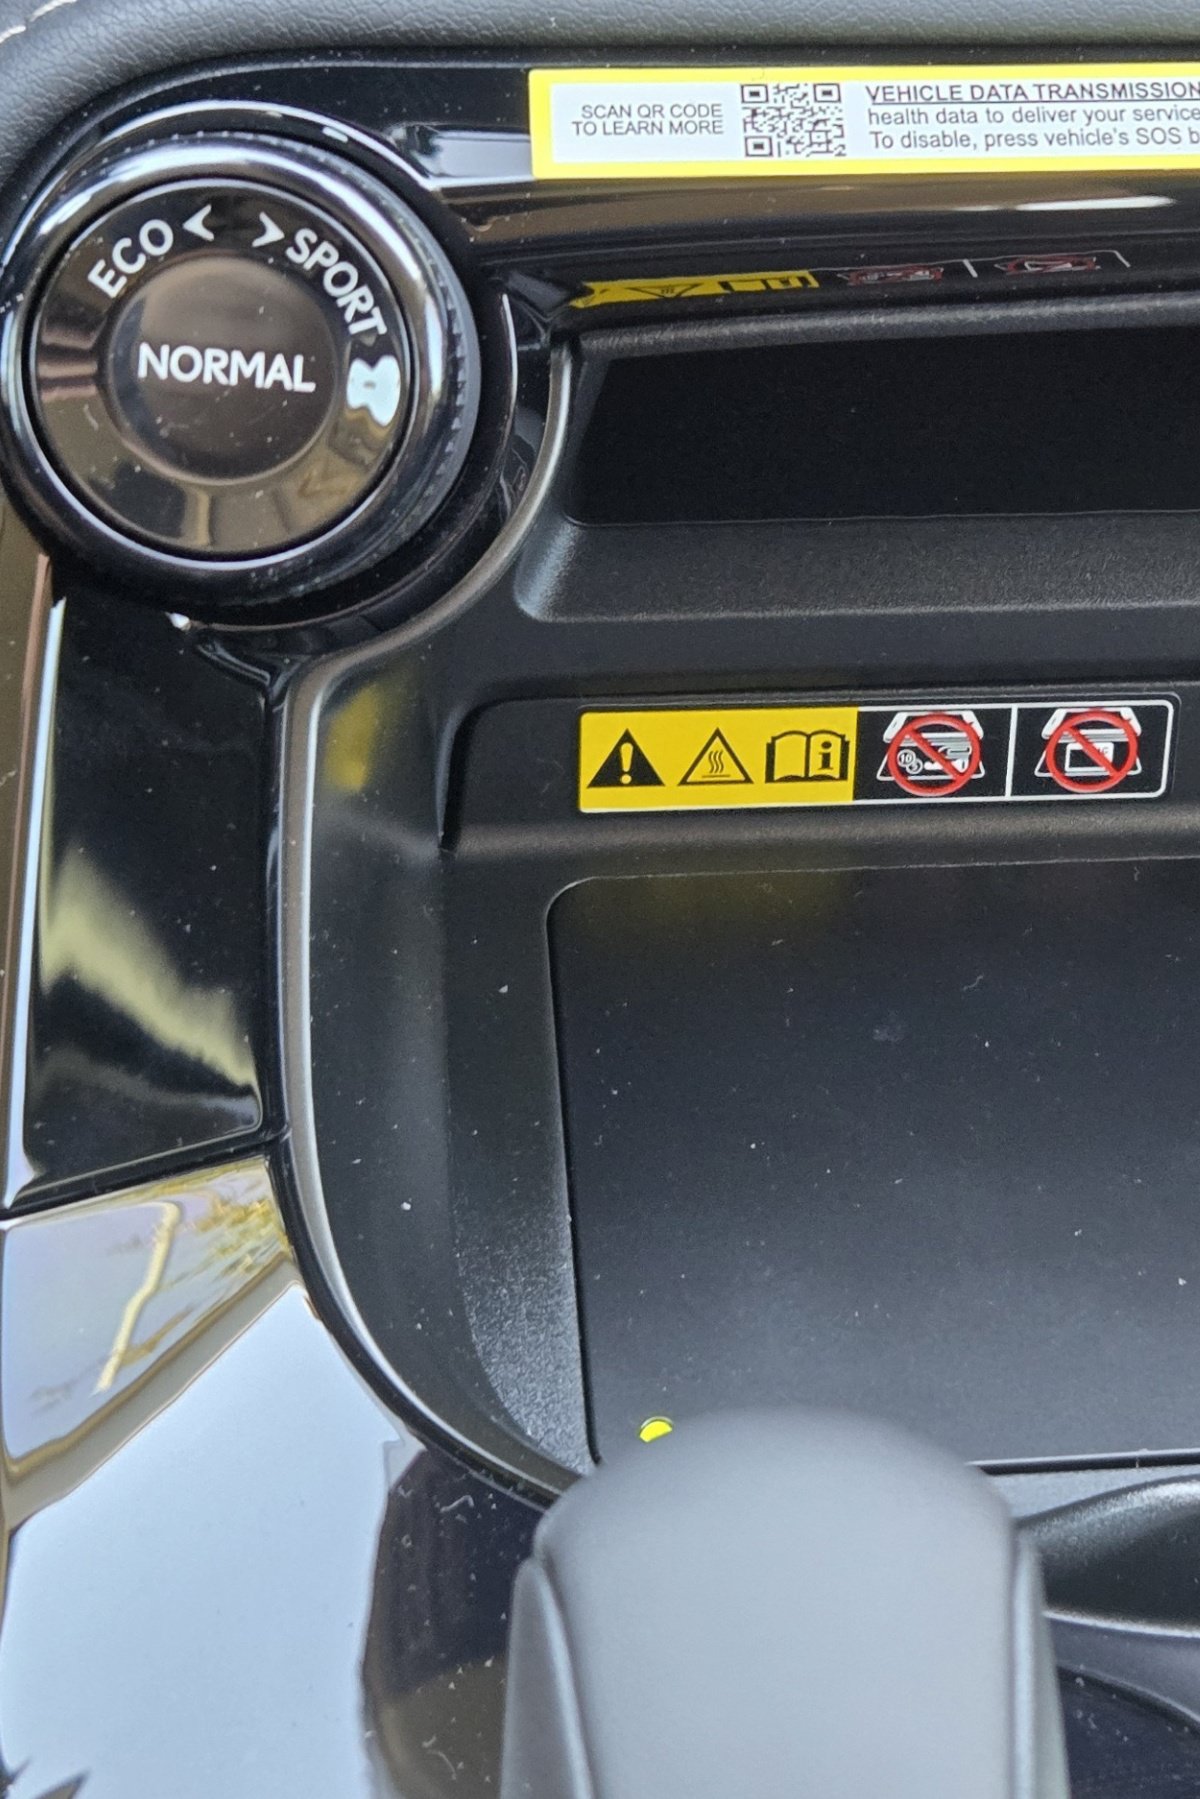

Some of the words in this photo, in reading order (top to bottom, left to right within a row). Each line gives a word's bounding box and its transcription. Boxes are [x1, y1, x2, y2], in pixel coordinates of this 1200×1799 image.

[866, 84, 963, 101] VEHICLE
[970, 84, 1028, 100] DATA
[582, 105, 632, 118] SCAN
[639, 104, 665, 118] QR
[671, 104, 723, 118] CODE
[868, 109, 928, 125] health
[936, 107, 978, 124] data
[985, 109, 1004, 123] to
[1012, 105, 1076, 123] deliver
[1083, 106, 1125, 127] your
[572, 121, 597, 135] TO
[602, 121, 663, 135] LEARN
[668, 120, 724, 134] MORE
[870, 131, 894, 148] To
[900, 130, 978, 151] disable,
[985, 131, 1038, 151] press
[1044, 128, 1129, 146] vehicle's
[1136, 127, 1181, 145] SOS
[88, 219, 174, 299] ECO
[285, 228, 387, 336] SPORT
[137, 342, 316, 392] NORMAL
